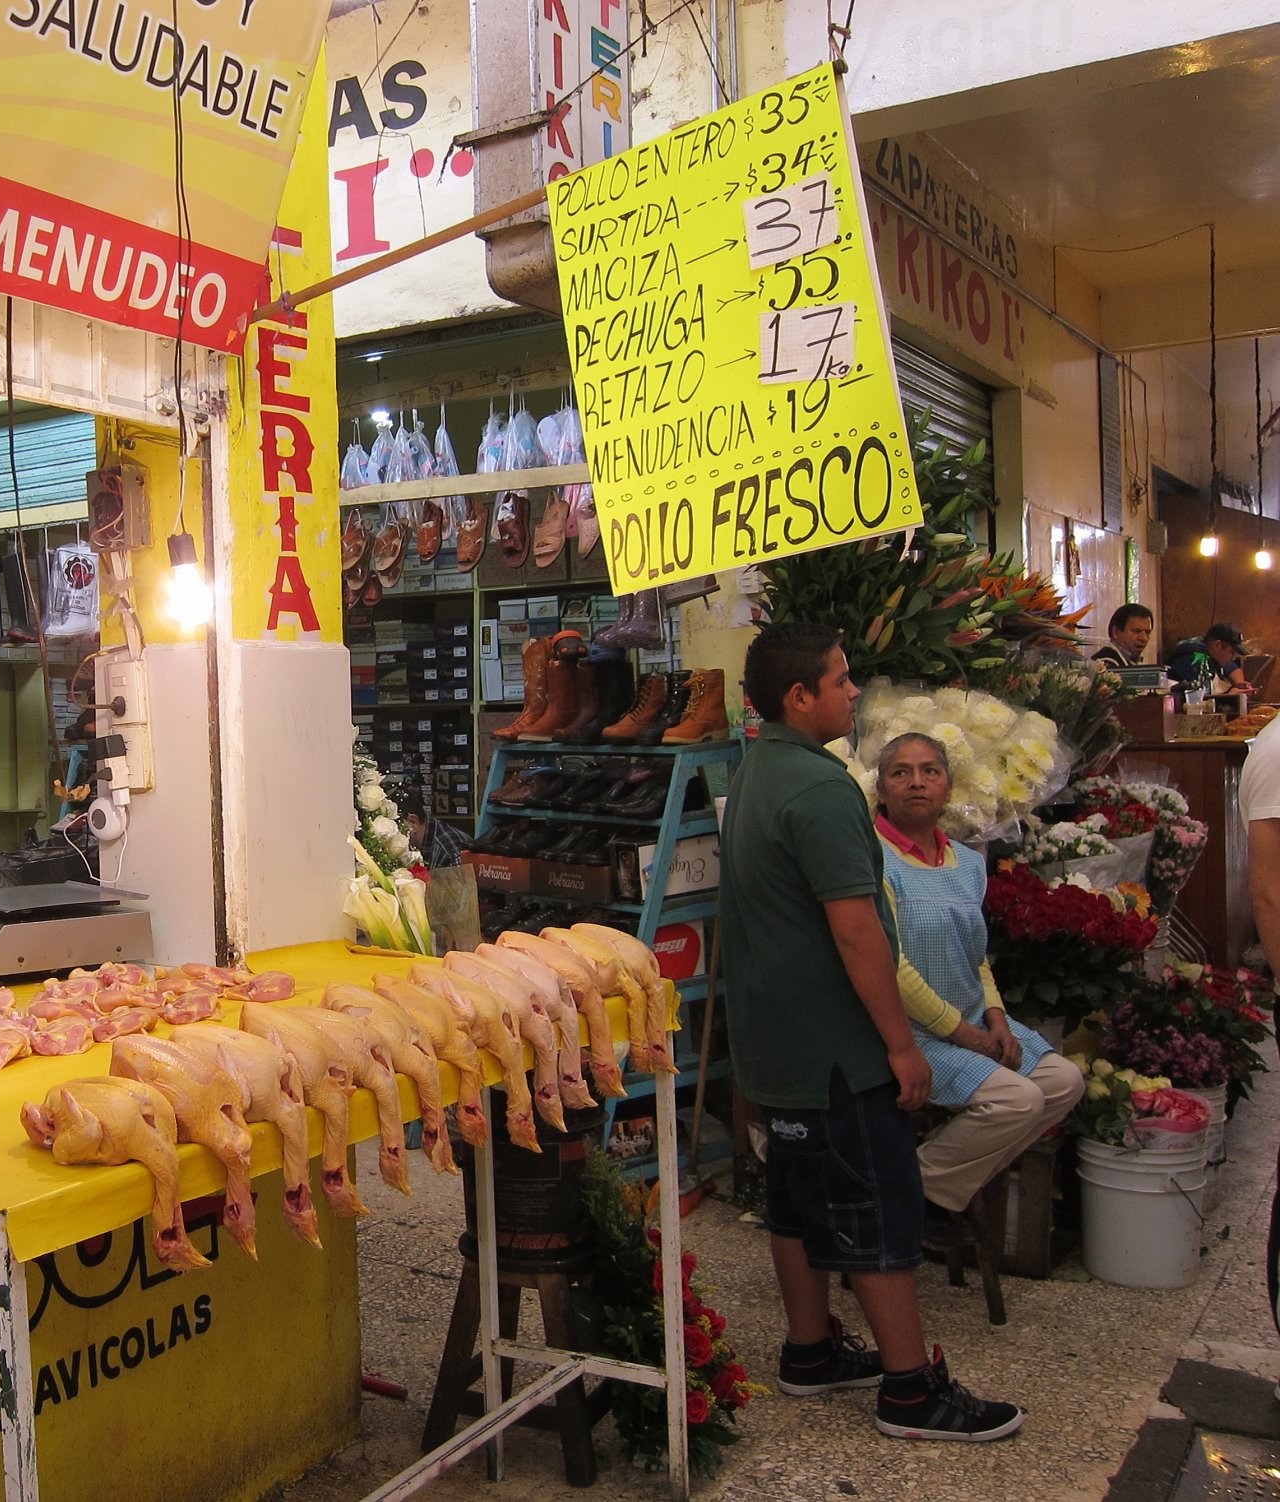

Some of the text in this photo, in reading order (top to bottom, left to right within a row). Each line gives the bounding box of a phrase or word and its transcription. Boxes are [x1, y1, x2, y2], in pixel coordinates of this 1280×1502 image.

[556, 157, 630, 227] POLLO
[635, 116, 737, 189] ENTERO
[566, 179, 836, 316] MACIZA 37
[896, 214, 992, 346] KIKO
[575, 283, 707, 375] PECHUGA
[583, 349, 707, 433] RETAZO
[757, 306, 849, 386] 17
[591, 400, 756, 484] MENUDENCIA
[610, 436, 893, 589] POLLO FRESCO
[36, 1293, 213, 1418] AVICOLAS
